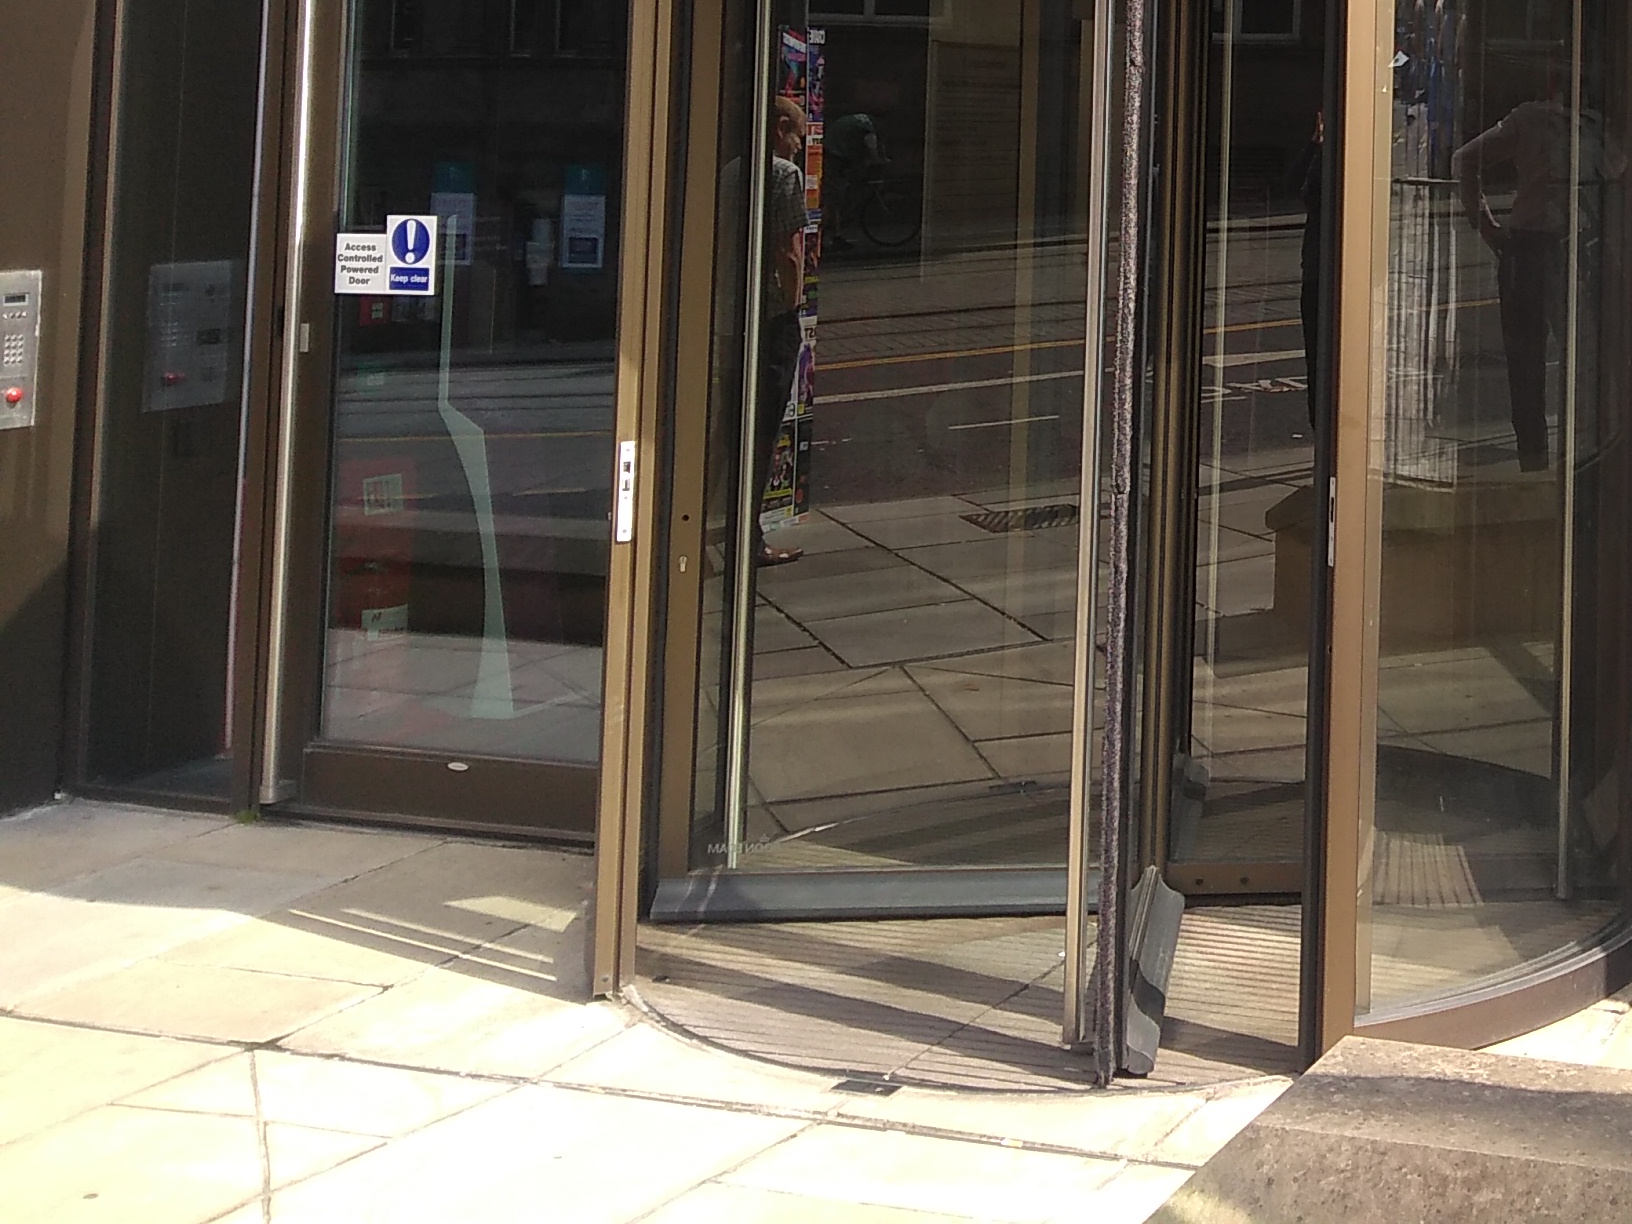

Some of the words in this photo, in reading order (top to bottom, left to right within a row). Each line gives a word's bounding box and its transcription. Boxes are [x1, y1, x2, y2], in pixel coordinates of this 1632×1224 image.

[344, 242, 377, 252] Access
[337, 254, 383, 263] Controlled
[340, 264, 379, 274] Powered
[348, 276, 371, 285] Door
[390, 274, 409, 284] Keep
[410, 274, 428, 283] clear
